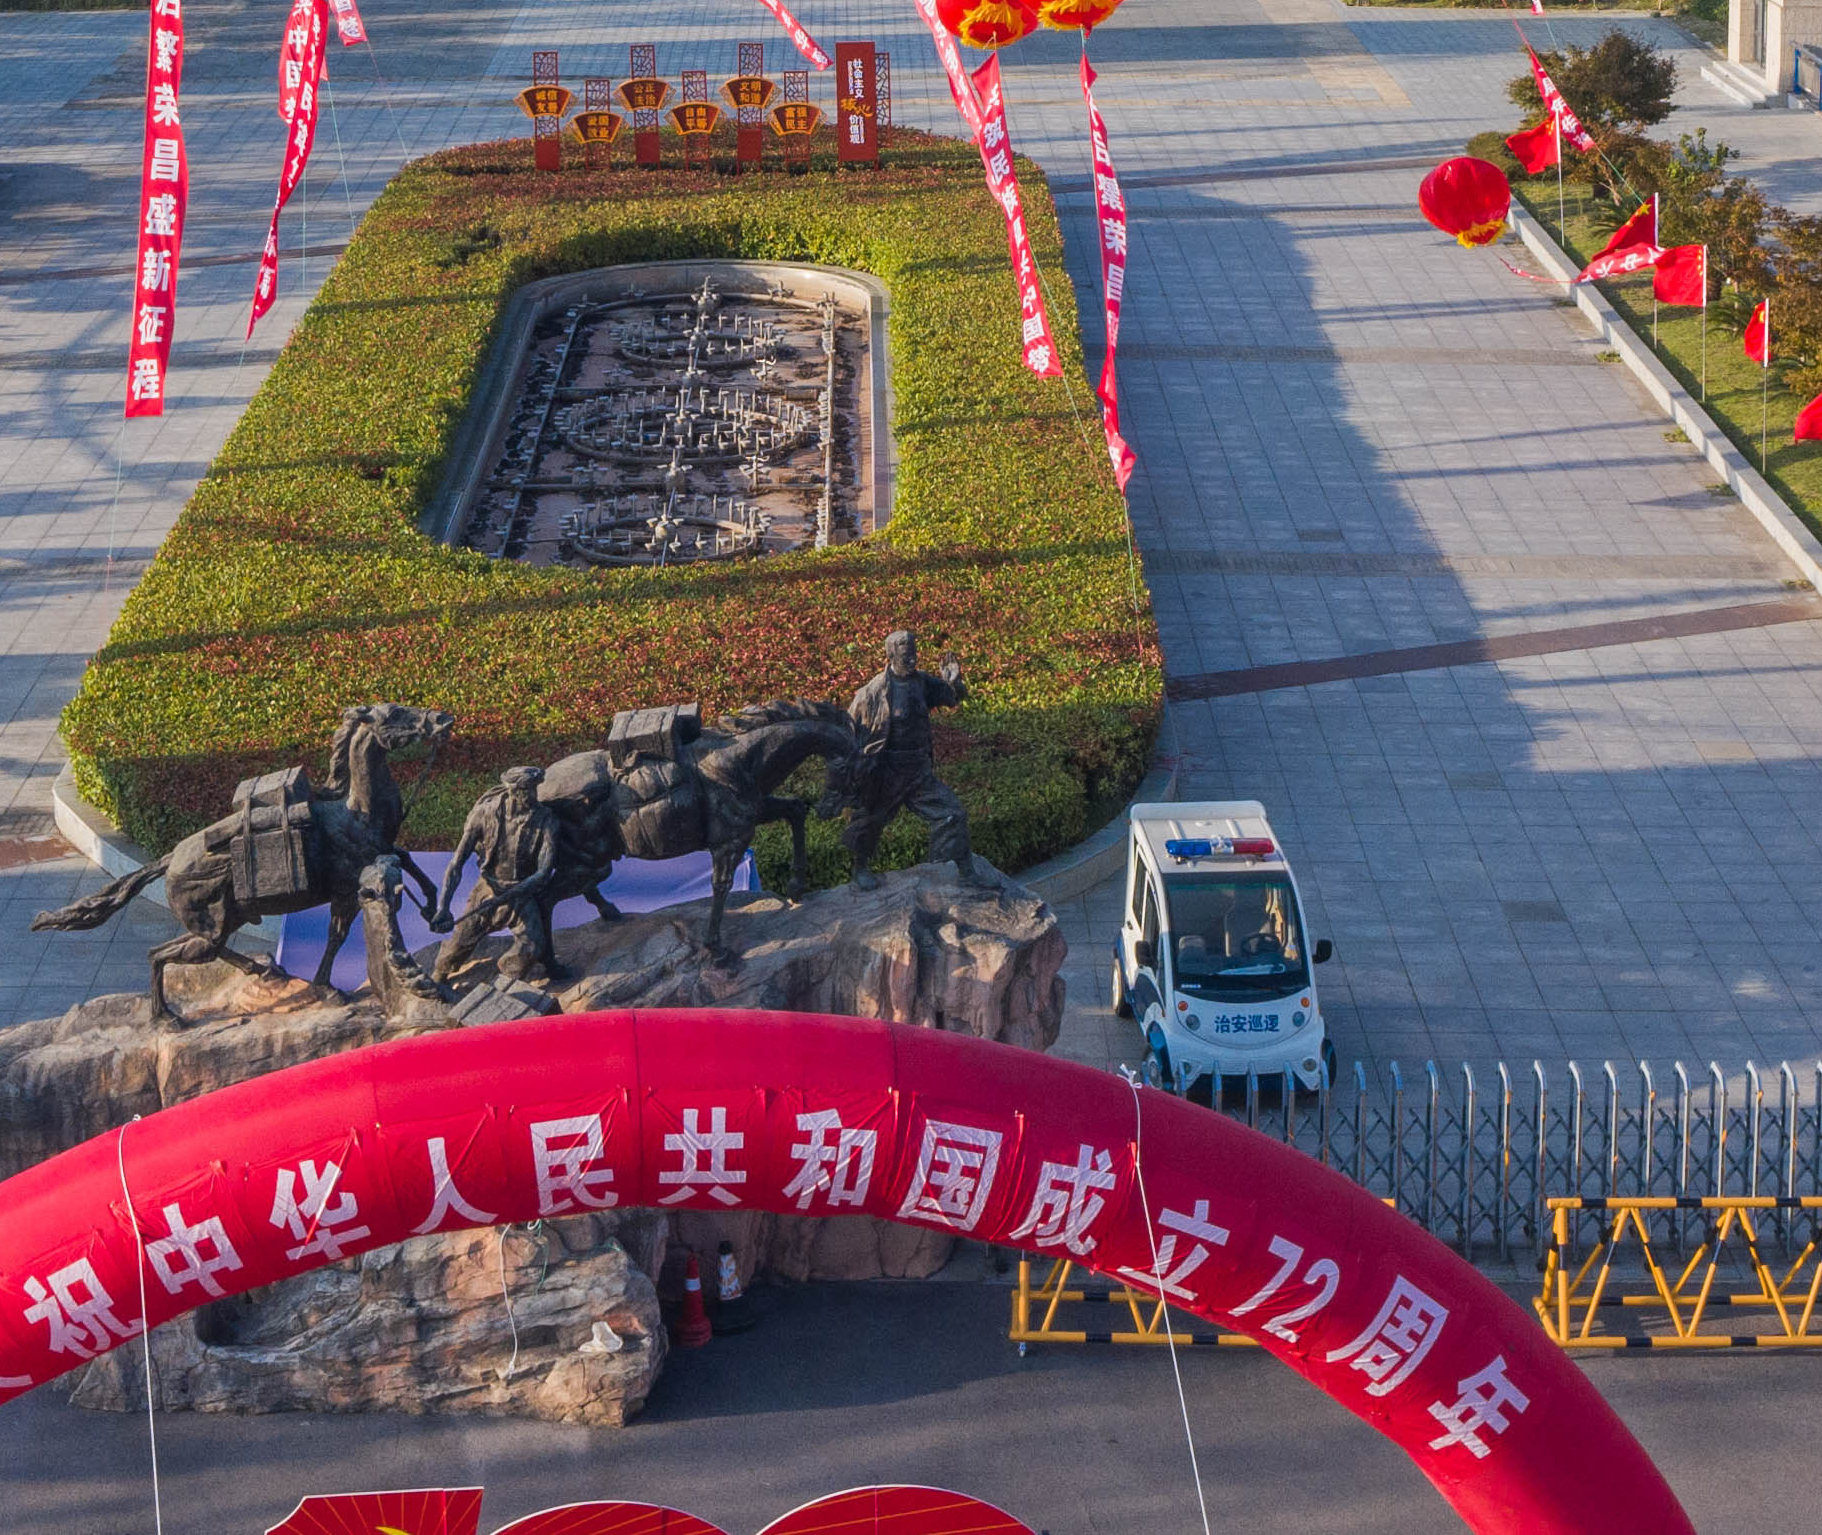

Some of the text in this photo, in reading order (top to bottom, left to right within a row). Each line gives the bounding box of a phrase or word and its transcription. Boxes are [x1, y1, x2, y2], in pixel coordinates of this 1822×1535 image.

[852, 58, 865, 99] 社会主义
[634, 82, 655, 94] 公正
[739, 81, 761, 91] 文明
[535, 89, 558, 101] 诚信
[634, 95, 656, 105] 法治
[740, 92, 762, 103] 和谐
[536, 101, 558, 113] 友善
[685, 107, 707, 118] 自由
[785, 107, 807, 118] 富强
[840, 97, 874, 117] 核心
[587, 115, 609, 126] 爱国
[686, 118, 707, 129] 平等
[785, 118, 808, 129] 民主
[587, 126, 609, 138] 敬业
[848, 114, 861, 144] 价值观
[1214, 1014, 1280, 1033] 治安巡逻
